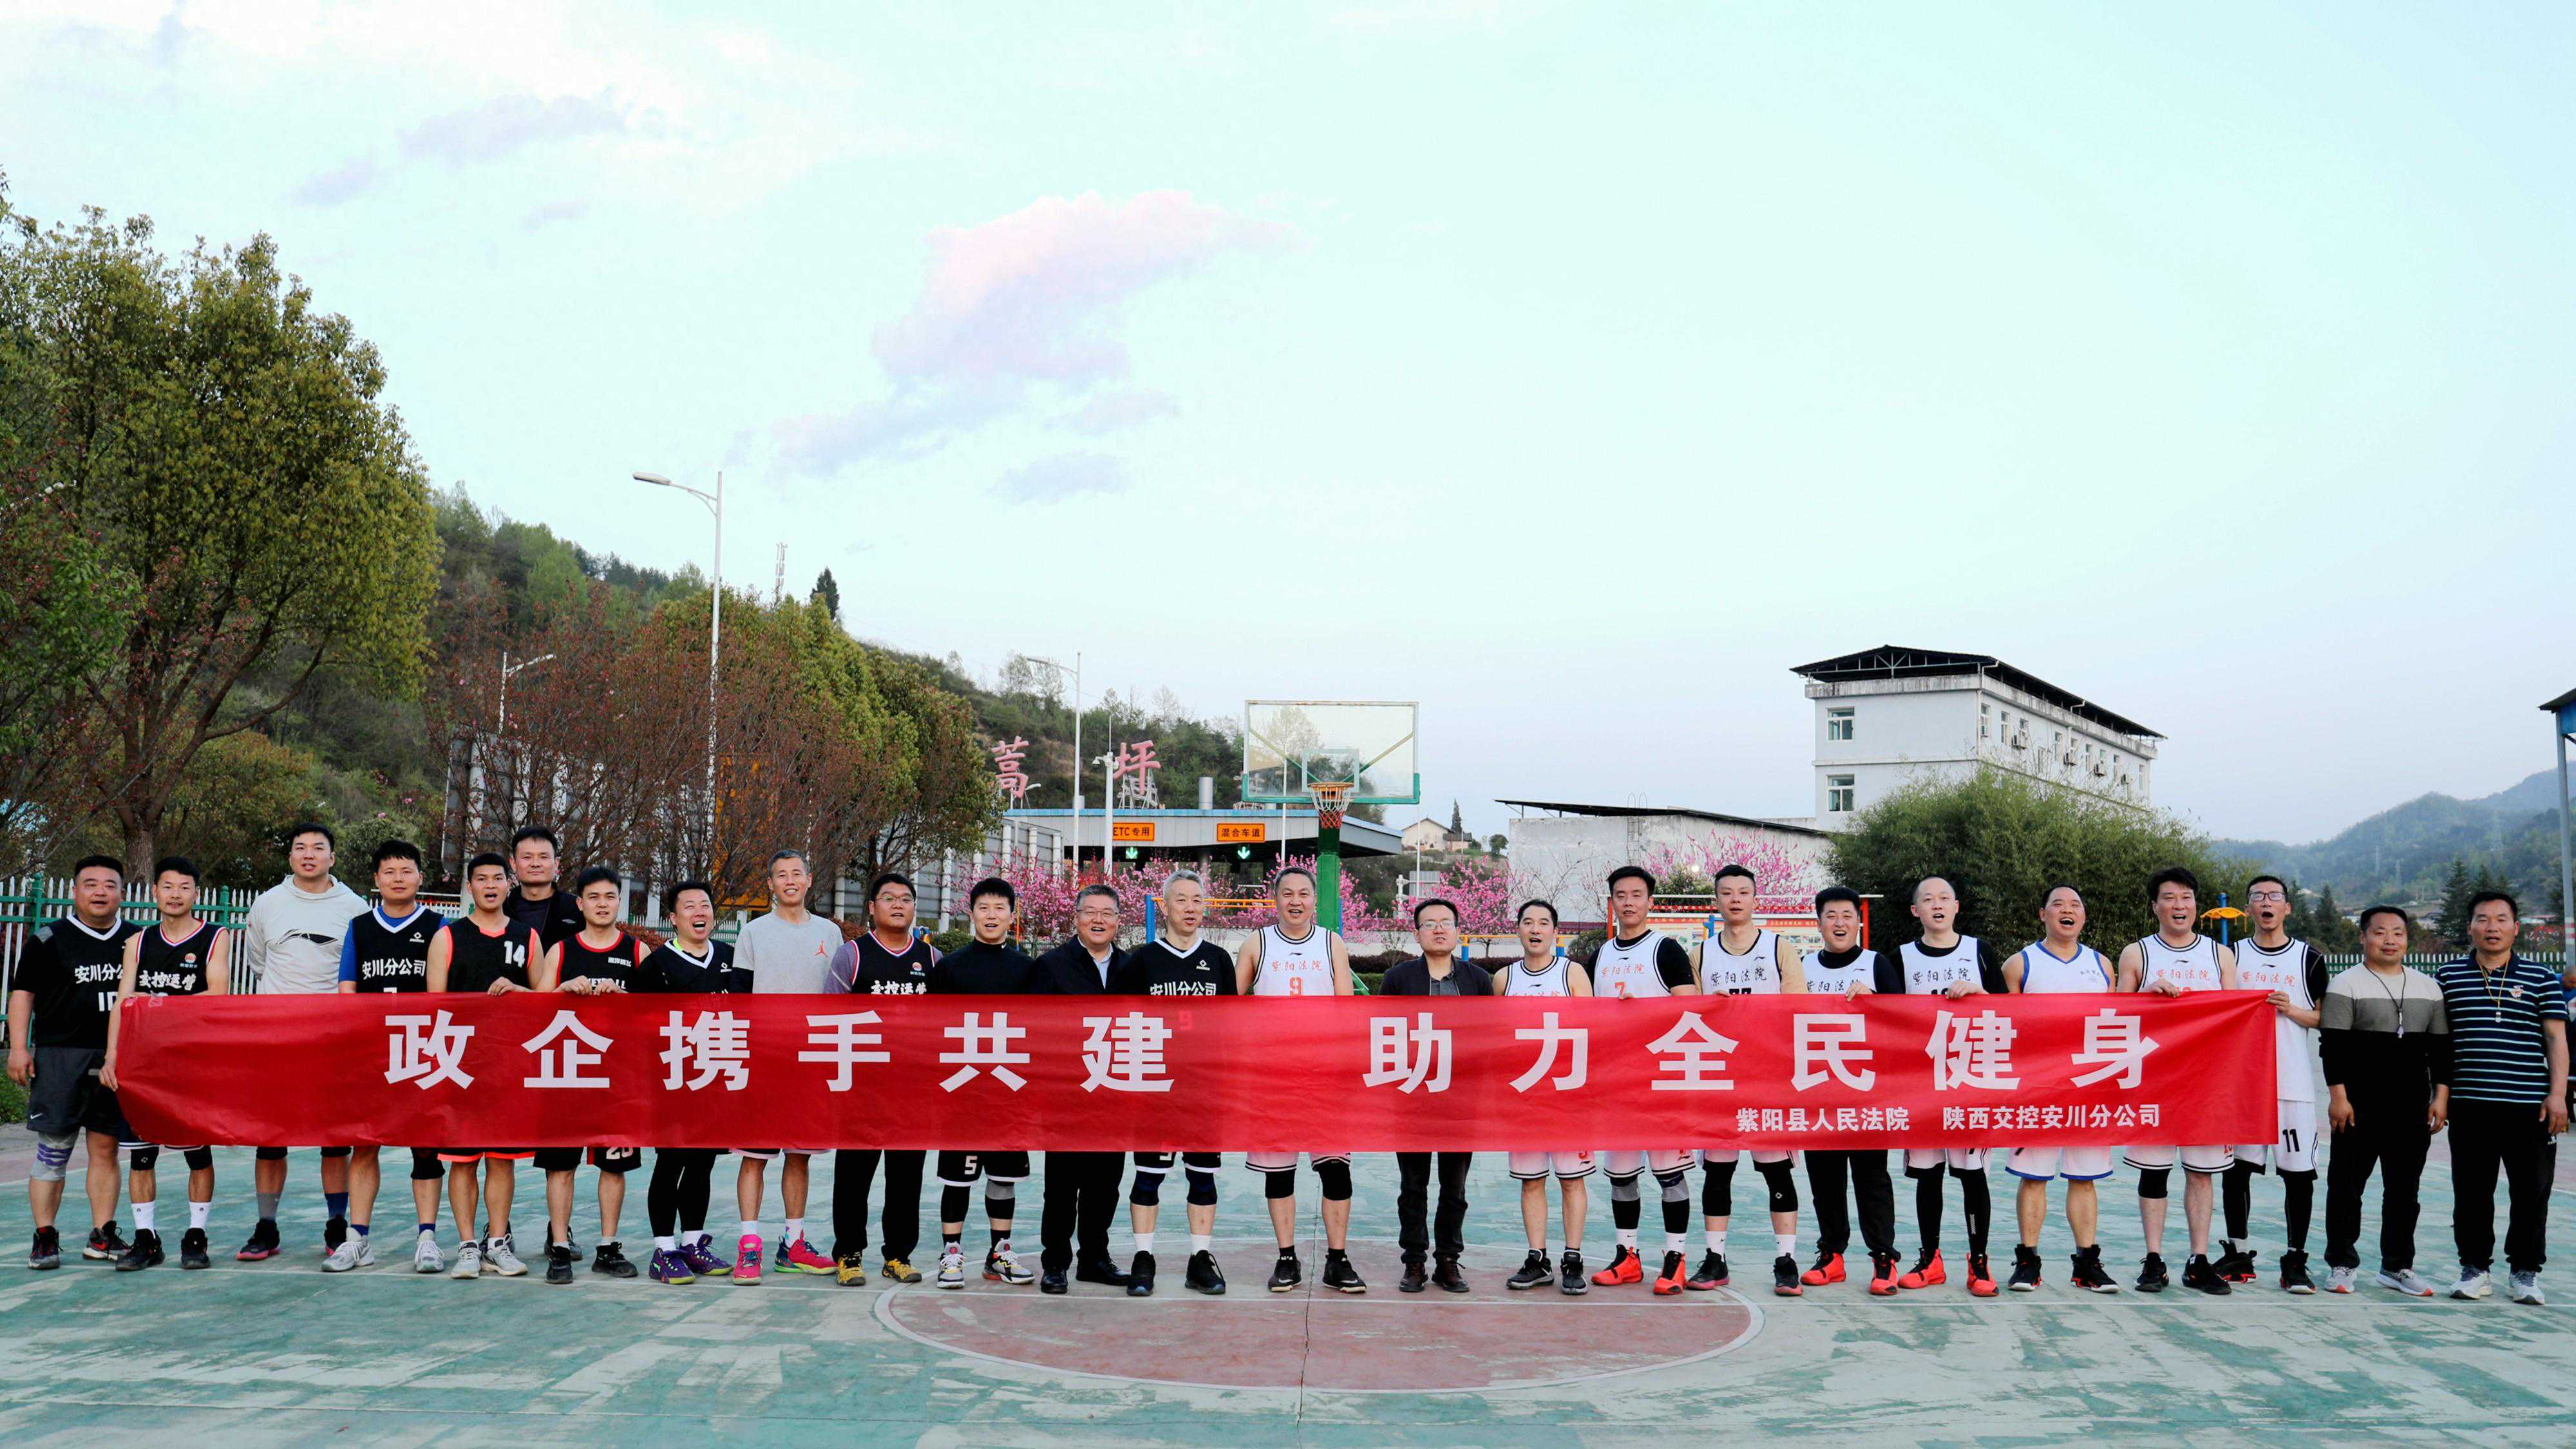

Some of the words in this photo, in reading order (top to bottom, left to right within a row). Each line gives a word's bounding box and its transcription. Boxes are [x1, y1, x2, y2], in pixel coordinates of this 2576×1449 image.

[992, 735, 1161, 799] 蒿坪
[1113, 827, 1130, 837] ETC
[1132, 827, 1150, 837] 专用
[1221, 828, 1260, 838] 混合车道
[504, 940, 526, 967] 14
[362, 958, 426, 980] 安川分公司
[1271, 960, 1323, 972] 紫阳法院
[1602, 963, 1645, 978] 紫阳法院
[2157, 969, 2210, 981] 紫阳法院
[1710, 967, 1767, 987] 紫阳法院
[1913, 967, 1971, 986] 紫阳法院
[2241, 971, 2296, 987] 紫阳法院
[1150, 981, 1217, 996] 安川分公司
[1615, 981, 1626, 998] 7
[384, 1009, 1174, 1093] 政企携手共建
[1362, 1008, 2160, 1094] 助力全民健身
[1736, 1106, 1909, 1132] 紫阳县人民法院
[1943, 1104, 2159, 1130] 陕西交控安川分公司
[2282, 1128, 2300, 1153] 11
[964, 1155, 978, 1175] 5
